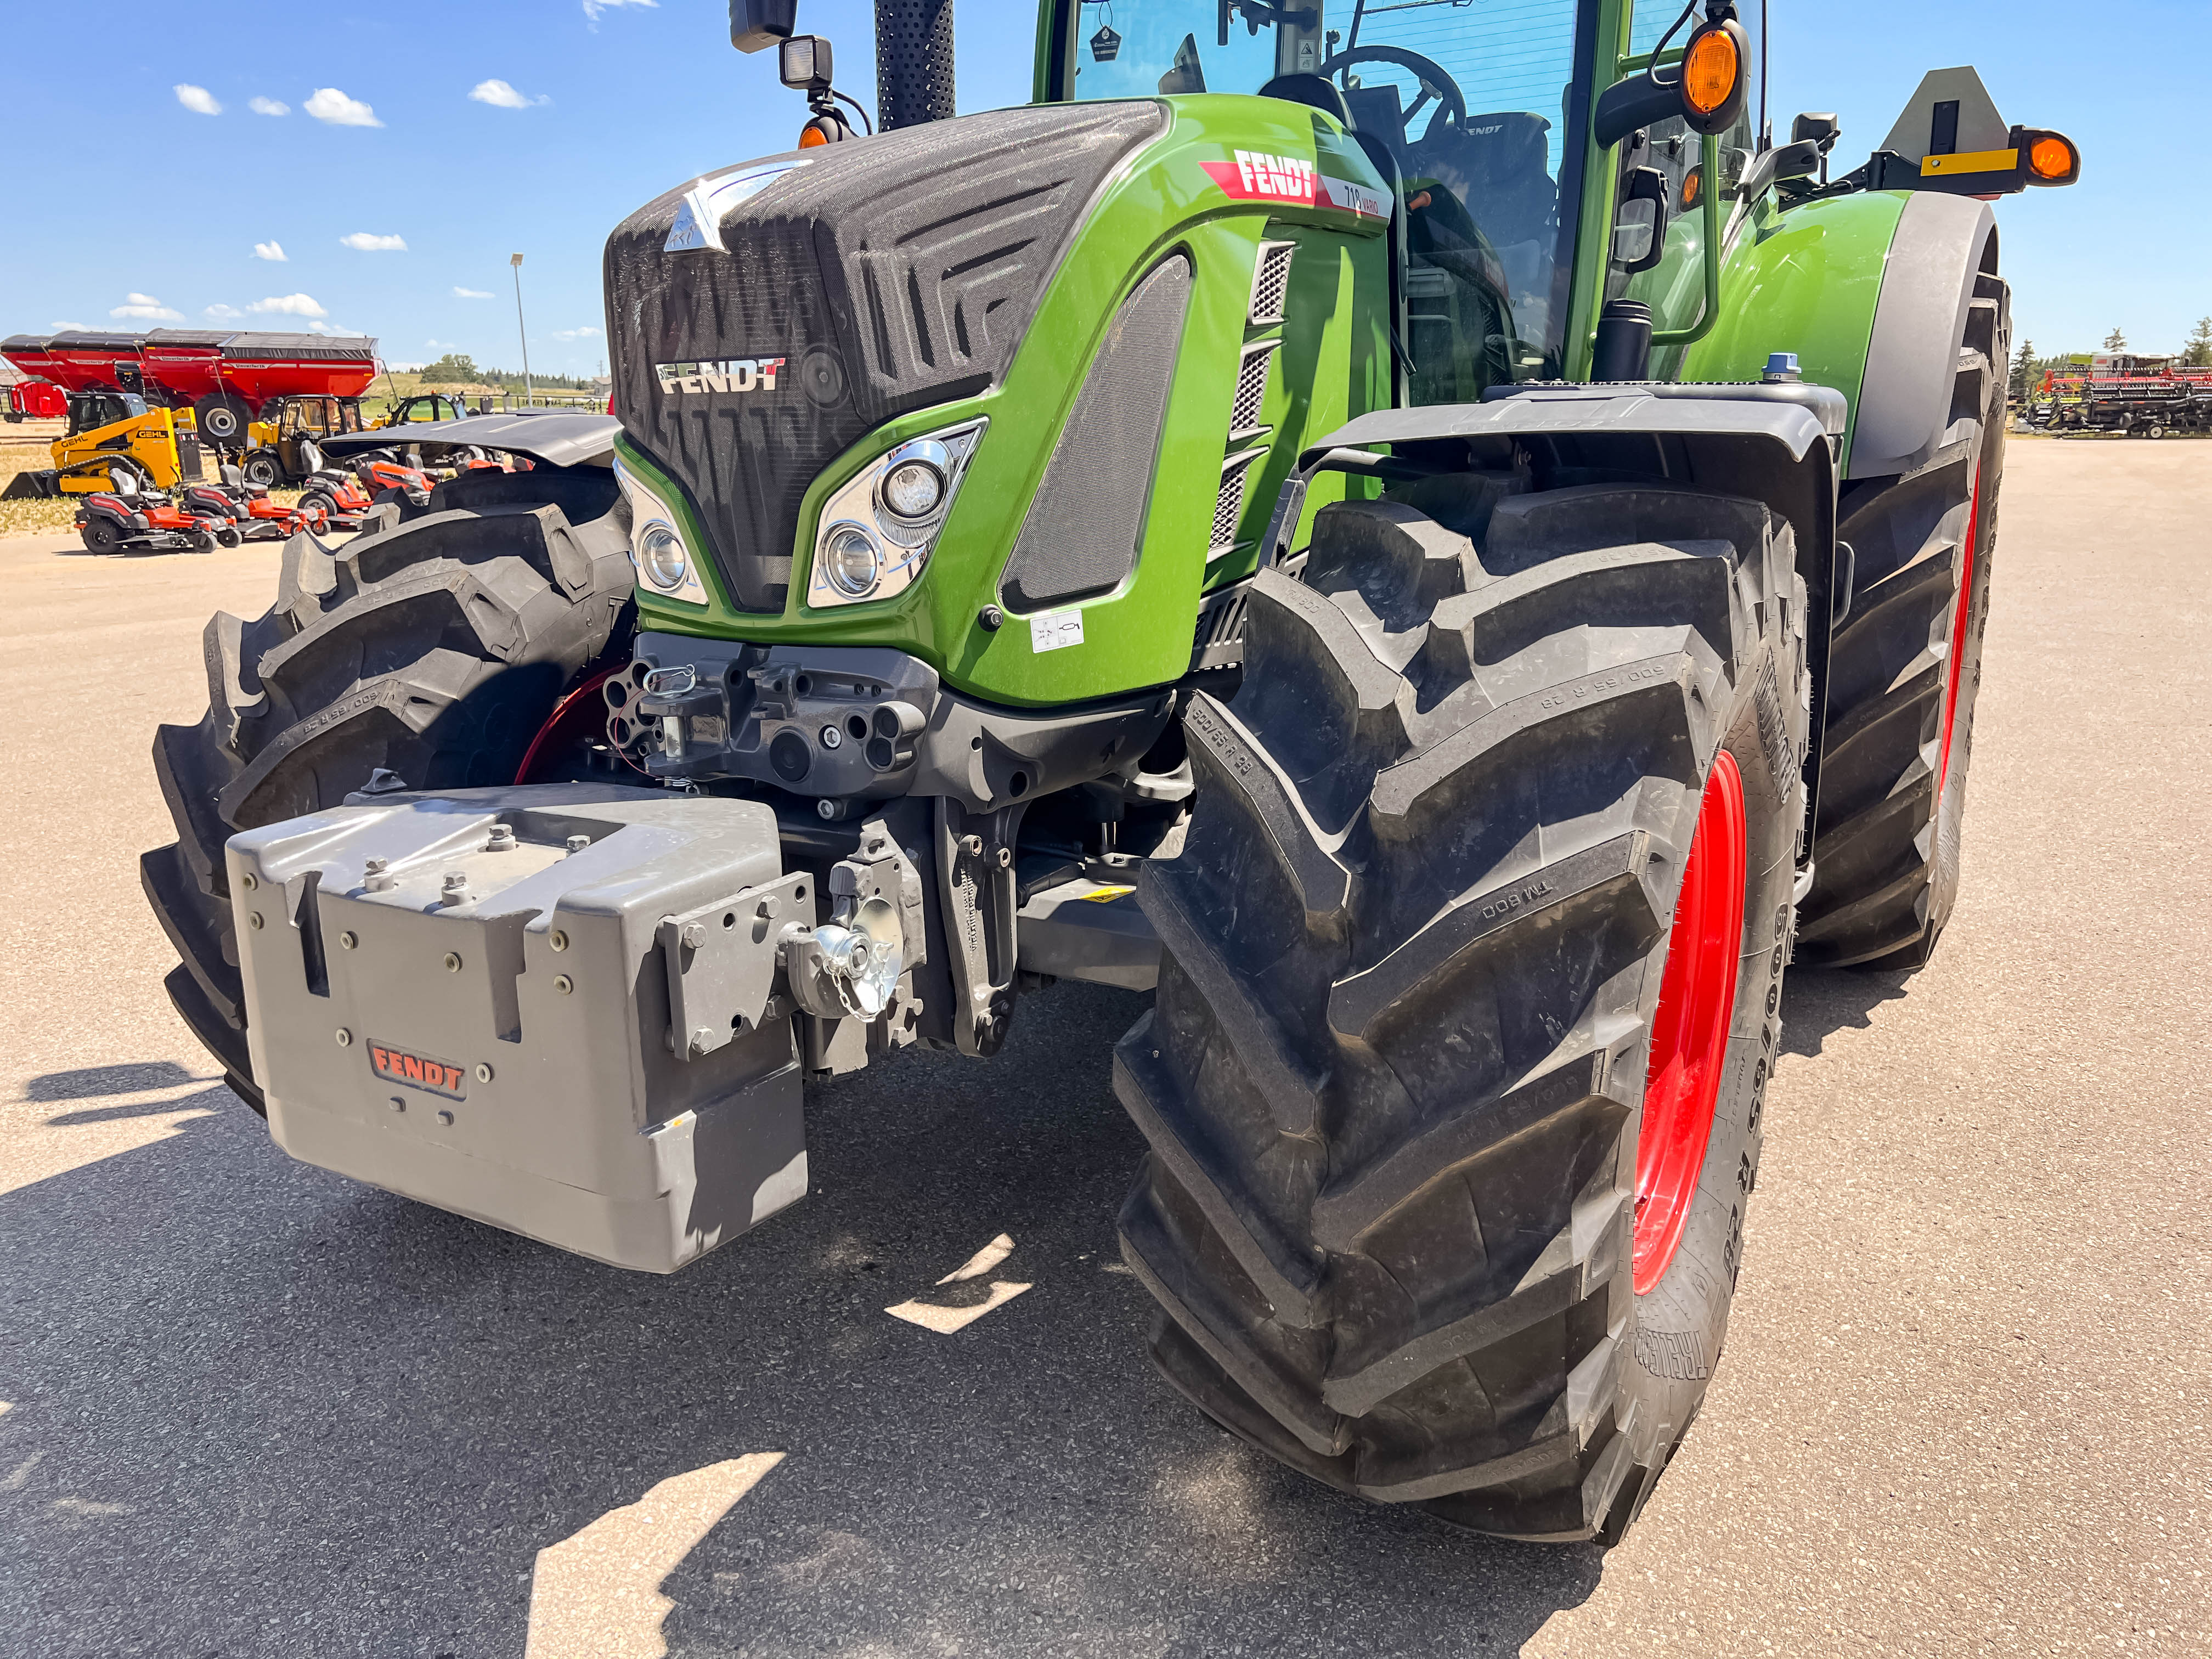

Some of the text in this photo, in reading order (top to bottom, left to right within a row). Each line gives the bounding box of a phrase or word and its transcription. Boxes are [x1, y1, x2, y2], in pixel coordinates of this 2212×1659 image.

[1464, 125, 1503, 136] ENDT
[1234, 149, 1313, 198] FENDT
[1344, 185, 1379, 215] 718 VARIO
[656, 357, 786, 394] FENDT
[61, 436, 88, 448] GEHL
[1299, 598, 1320, 614] 800
[1541, 665, 1665, 709] 600/65 R 28
[1224, 744, 1238, 758] R
[1234, 755, 1254, 776] 28
[1482, 881, 1554, 920] TM 800
[373, 1047, 462, 1091] FENDT
[1722, 901, 1788, 1284] 600/65 R 28
